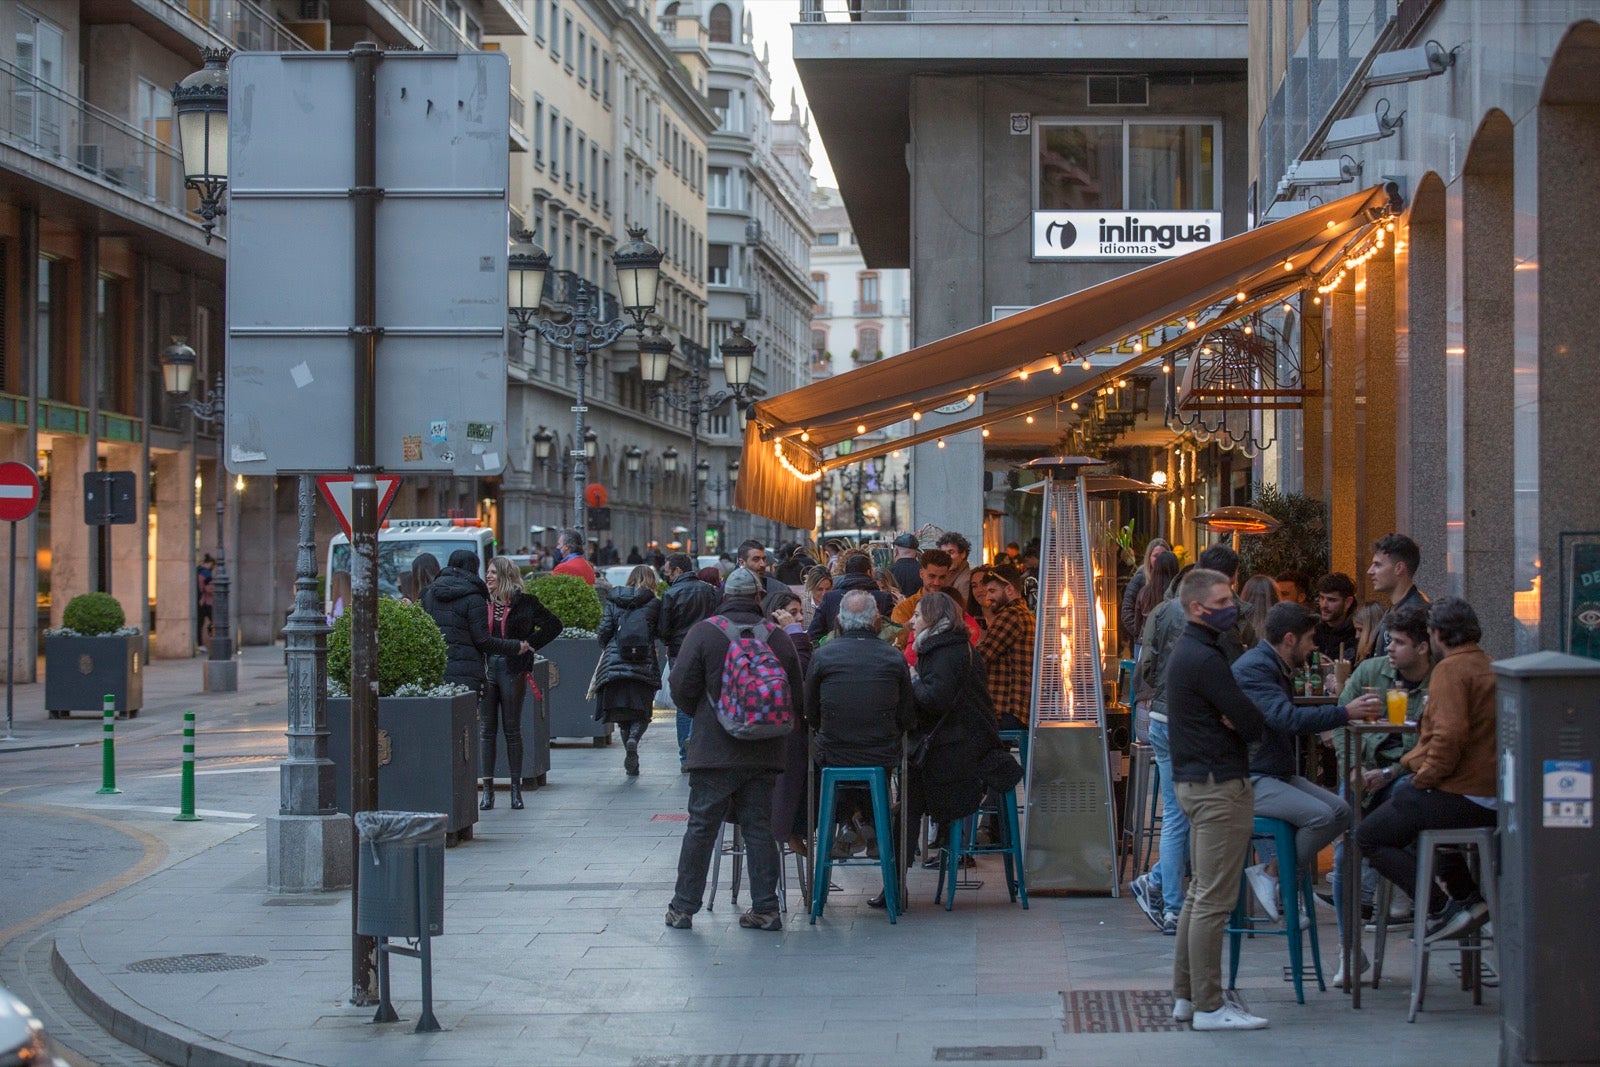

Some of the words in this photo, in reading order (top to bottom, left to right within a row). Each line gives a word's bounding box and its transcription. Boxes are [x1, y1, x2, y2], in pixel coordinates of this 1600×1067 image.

[1099, 216, 1211, 250] inlingua
[1099, 243, 1157, 254] idiomas
[398, 520, 443, 528] GRUA
